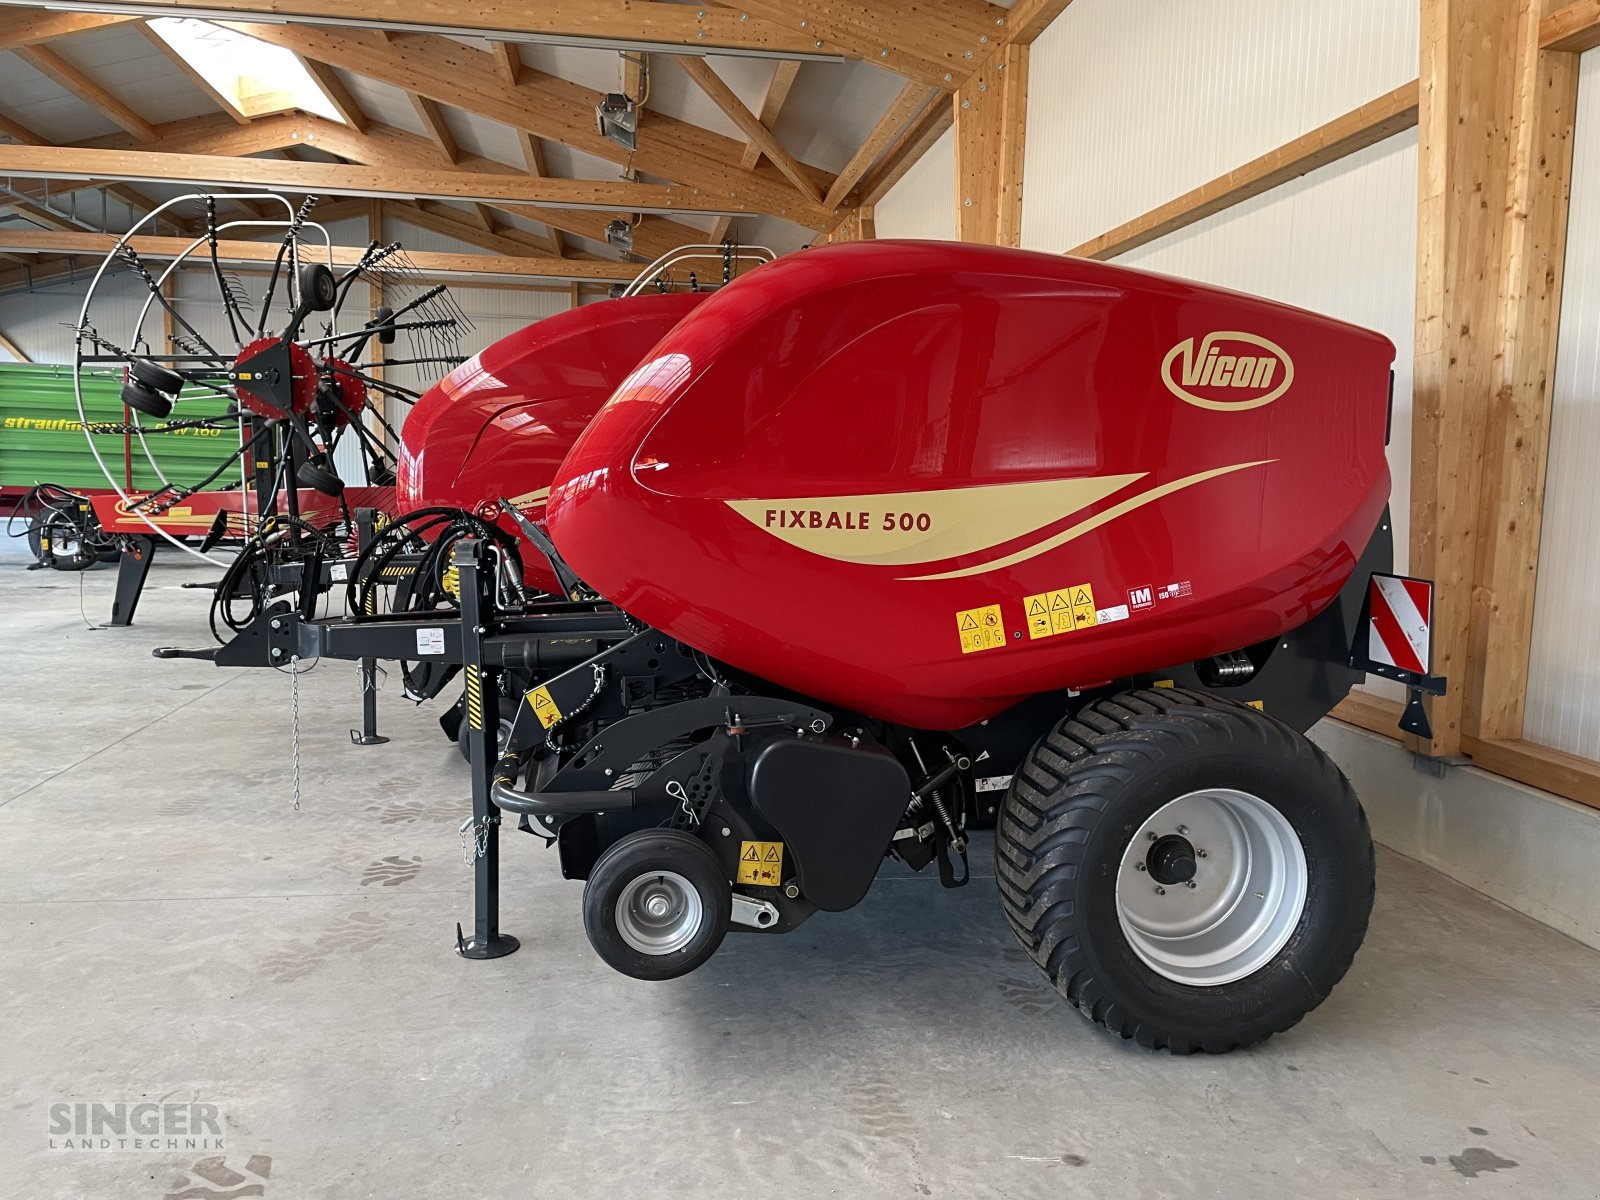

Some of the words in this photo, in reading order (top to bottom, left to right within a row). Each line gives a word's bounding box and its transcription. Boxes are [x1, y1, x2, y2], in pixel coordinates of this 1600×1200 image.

[1181, 333, 1277, 388] Vicon
[4, 417, 118, 433] strautm
[766, 509, 869, 530] FIXBALE
[882, 512, 931, 532] 500
